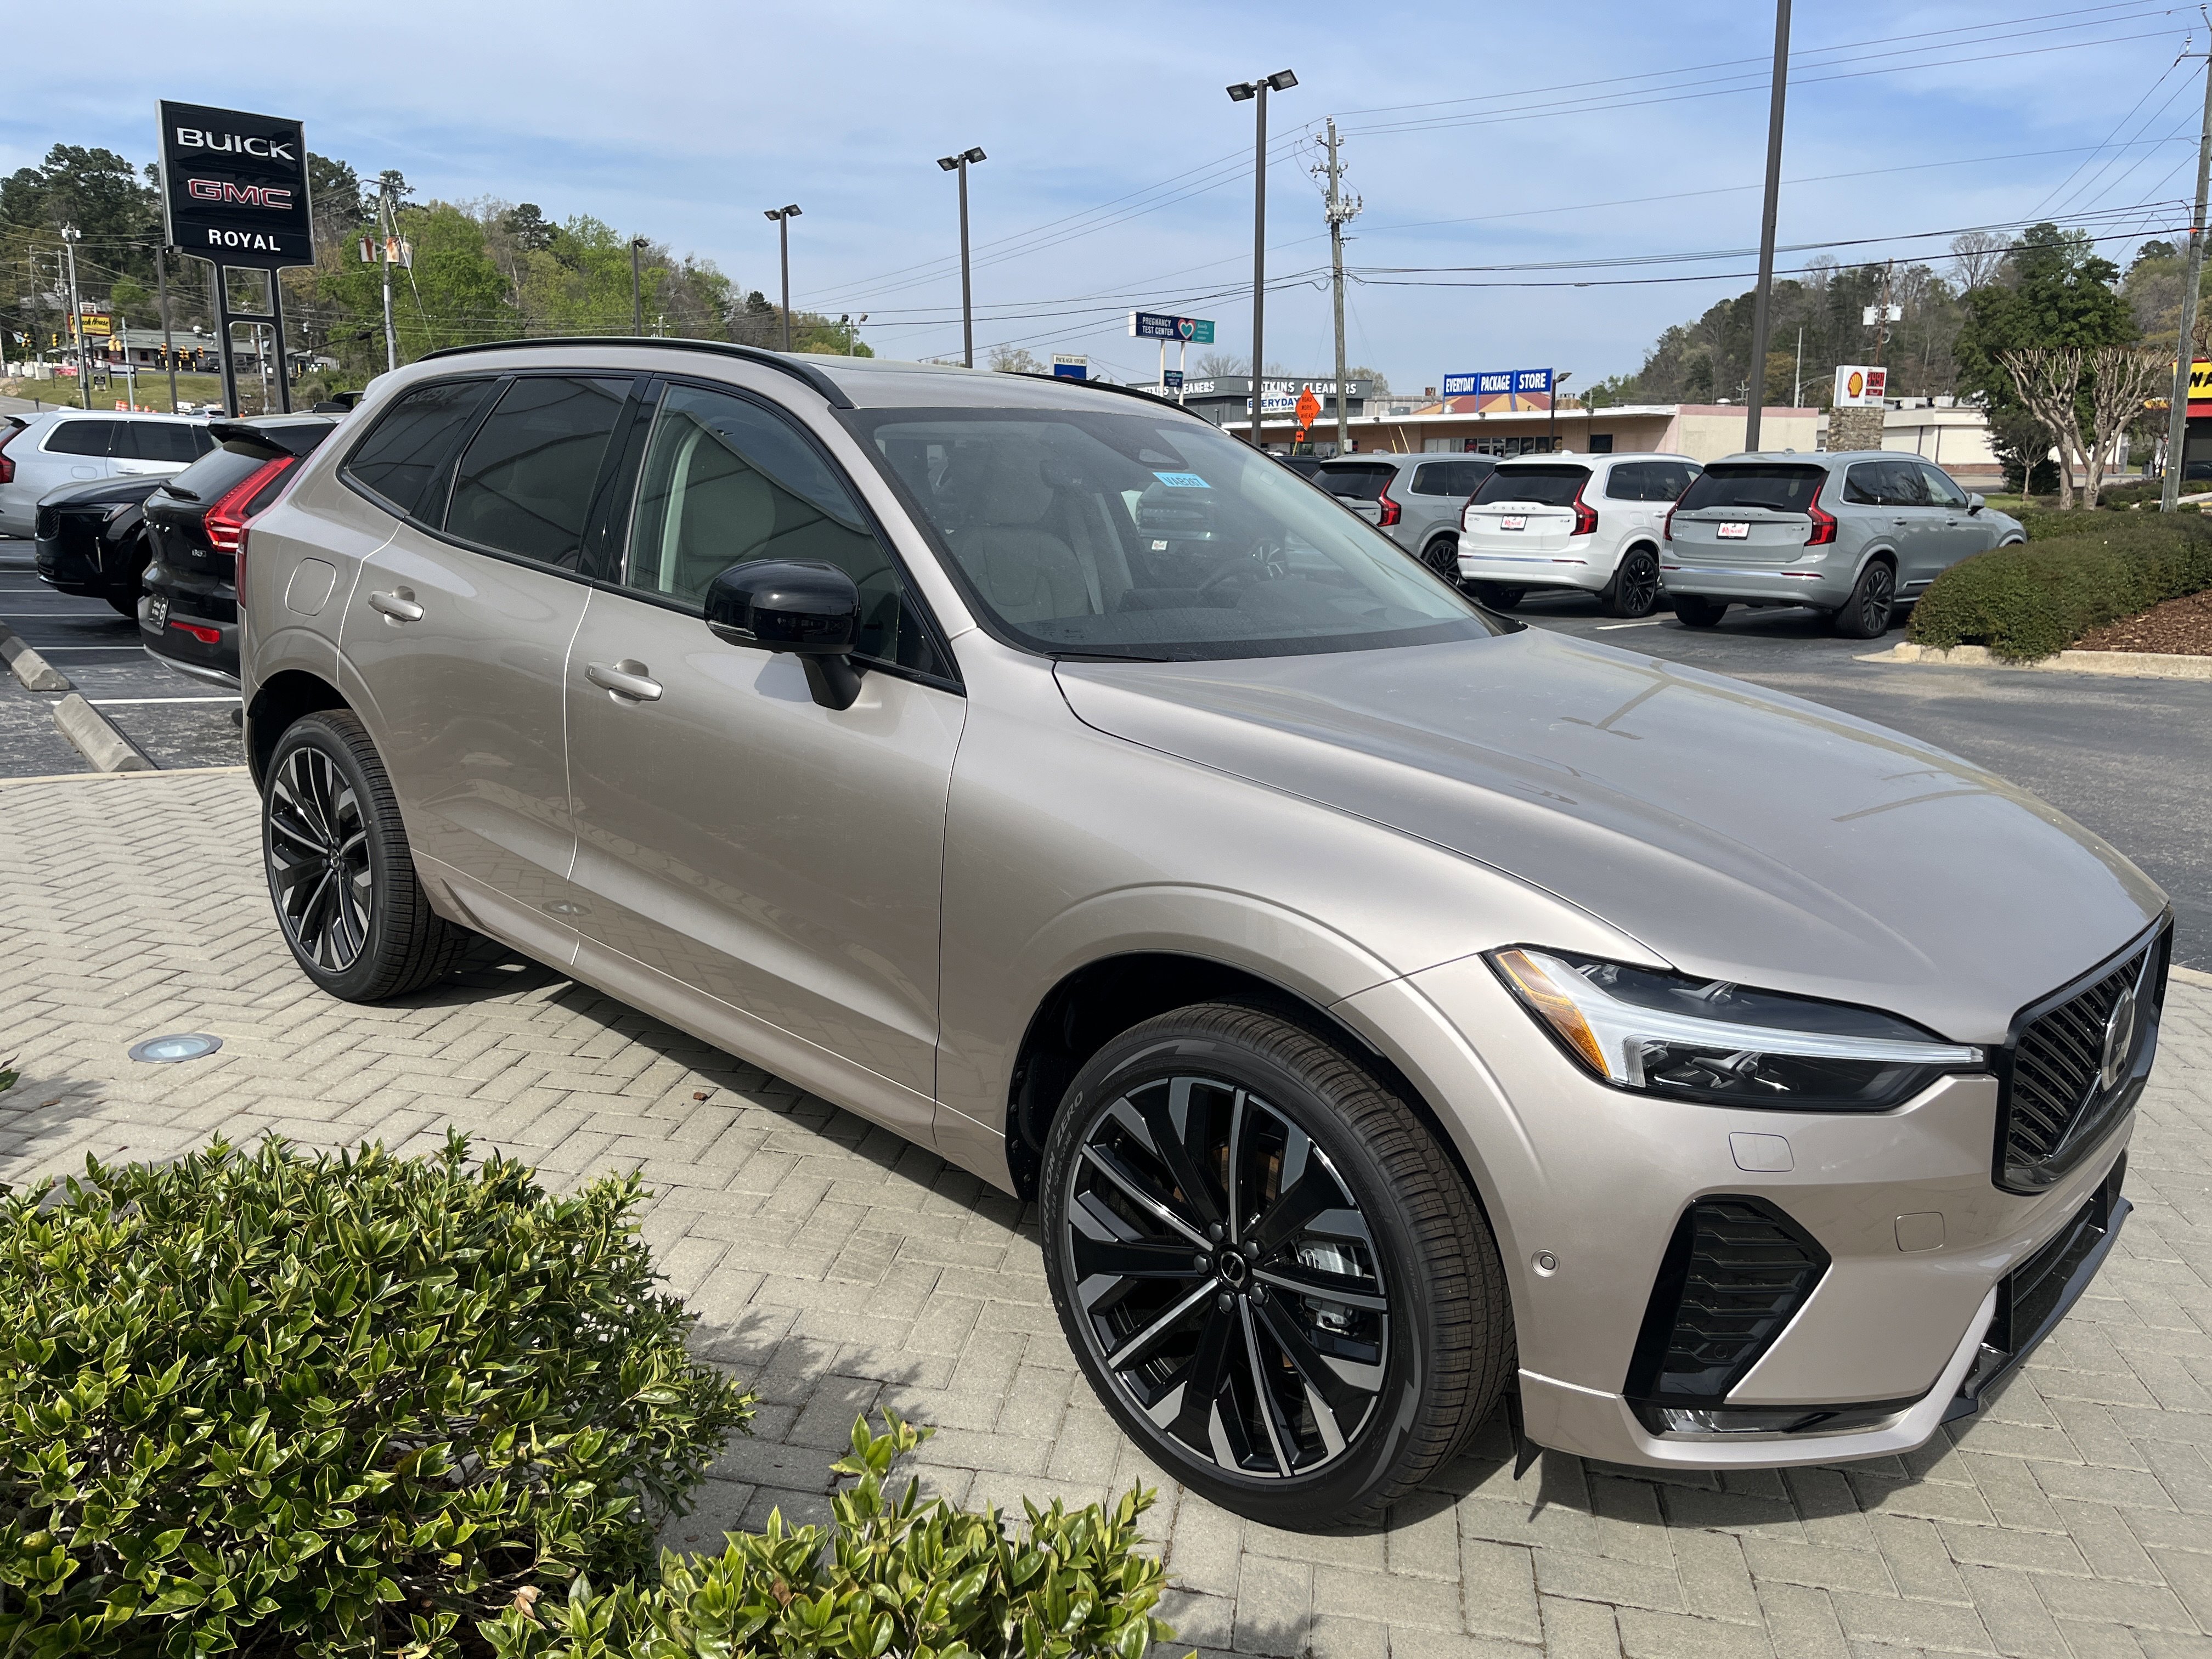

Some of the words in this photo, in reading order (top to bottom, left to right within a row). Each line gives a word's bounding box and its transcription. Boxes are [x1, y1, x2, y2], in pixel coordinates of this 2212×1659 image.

[177, 127, 295, 160] BUICK
[188, 178, 292, 209] GMC
[208, 229, 281, 251] ROYAL
[1142, 317, 1171, 327] PREGNANCY
[1142, 325, 1154, 334] TEST
[1155, 326, 1174, 336] CENTER
[1173, 381, 1215, 395] CEANERS
[1302, 382, 1357, 394] CLEANRS
[1446, 377, 1475, 393] EVERYDAY
[1481, 375, 1511, 392] PACKAGE
[1519, 373, 1547, 390] STORE
[1162, 476, 1203, 487] VAB267
[1055, 1090, 1084, 1148] ZERO
